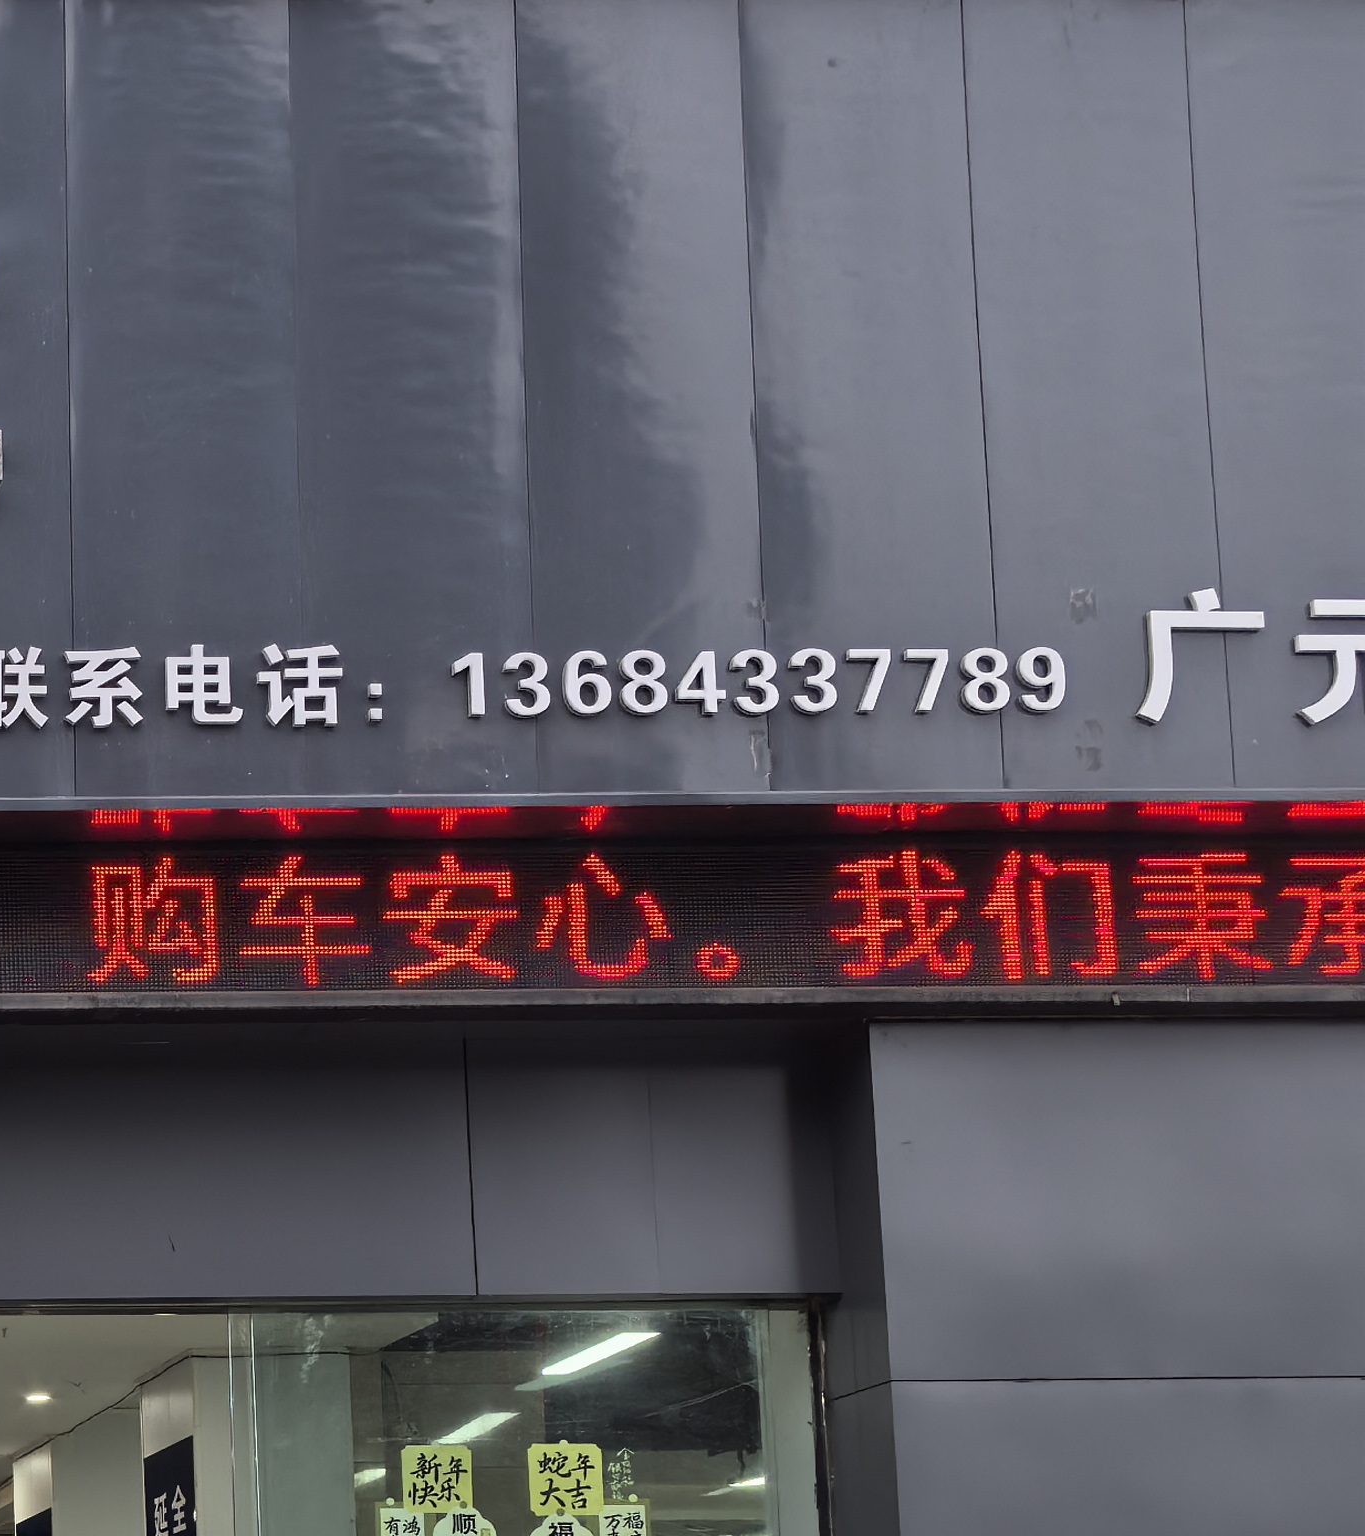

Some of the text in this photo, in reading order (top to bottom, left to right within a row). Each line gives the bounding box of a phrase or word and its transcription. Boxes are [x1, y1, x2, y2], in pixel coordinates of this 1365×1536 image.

[451, 647, 1067, 719] 13684337789
[409, 1453, 468, 1485] 新年
[537, 1452, 596, 1481] 蛇年
[408, 1477, 461, 1508] 快乐
[539, 1478, 592, 1510] 大吉
